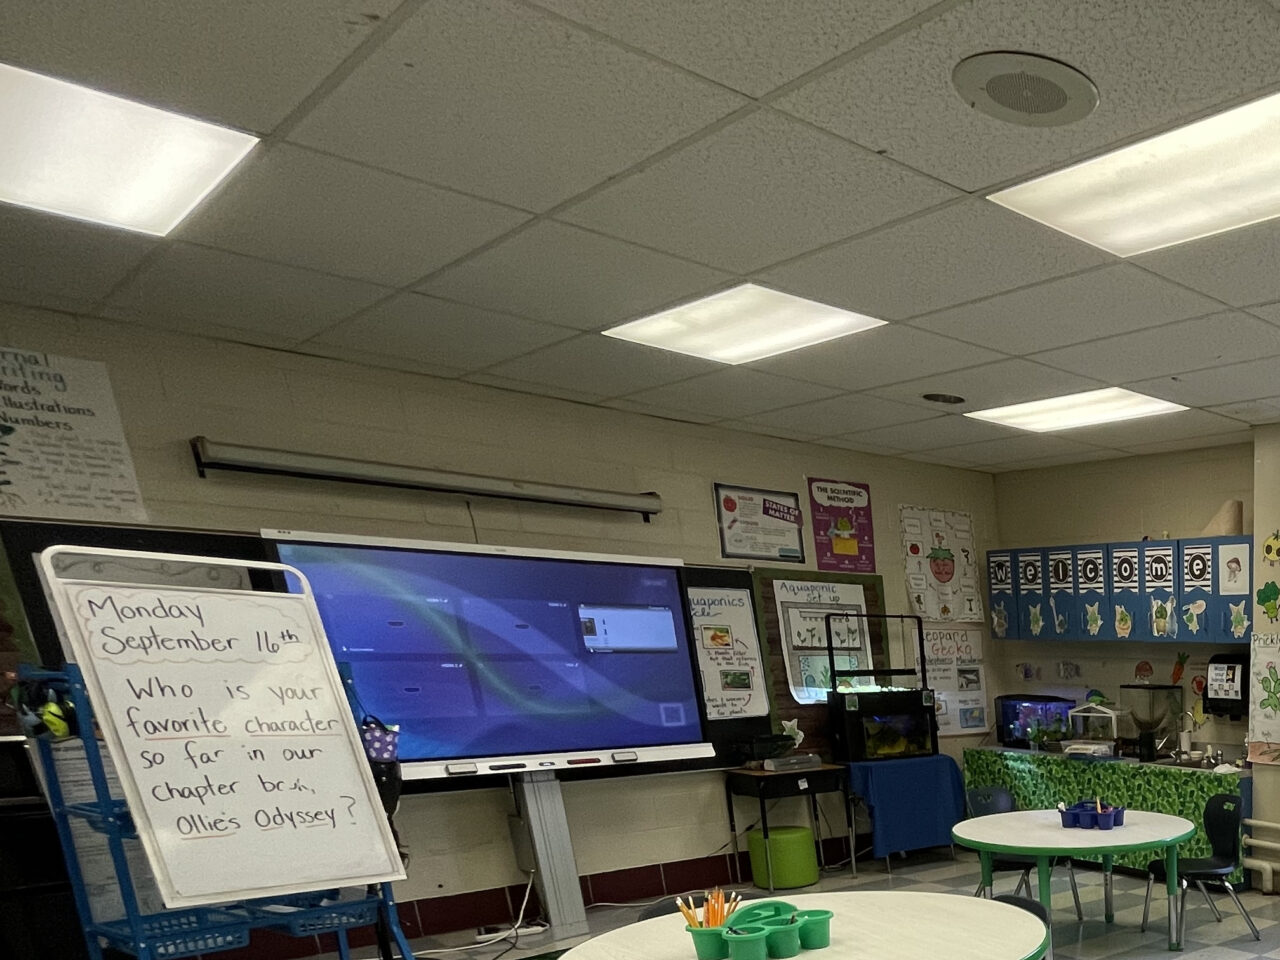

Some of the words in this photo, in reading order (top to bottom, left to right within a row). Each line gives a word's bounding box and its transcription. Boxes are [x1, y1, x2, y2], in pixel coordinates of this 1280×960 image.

[816, 486, 828, 494] THE
[830, 488, 864, 497] SCIENTIFIC
[827, 495, 855, 504] METHOD
[765, 501, 788, 513] STATES
[790, 508, 799, 516] OF
[769, 510, 796, 521] MATTER
[780, 582, 837, 596] Aquaponic
[829, 595, 840, 604] up
[87, 596, 204, 627] Monday
[101, 626, 240, 655] September
[256, 630, 300, 654] 16th
[925, 631, 968, 644] eopard
[932, 643, 972, 656] Gecko
[126, 676, 193, 700] Who
[224, 680, 250, 700] is
[267, 686, 323, 705] your
[126, 706, 228, 737] favorite
[244, 710, 342, 734] character
[140, 749, 165, 769] so
[184, 741, 225, 769] far
[241, 745, 265, 761] in
[283, 747, 324, 761] our
[177, 811, 241, 836] Ollie's
